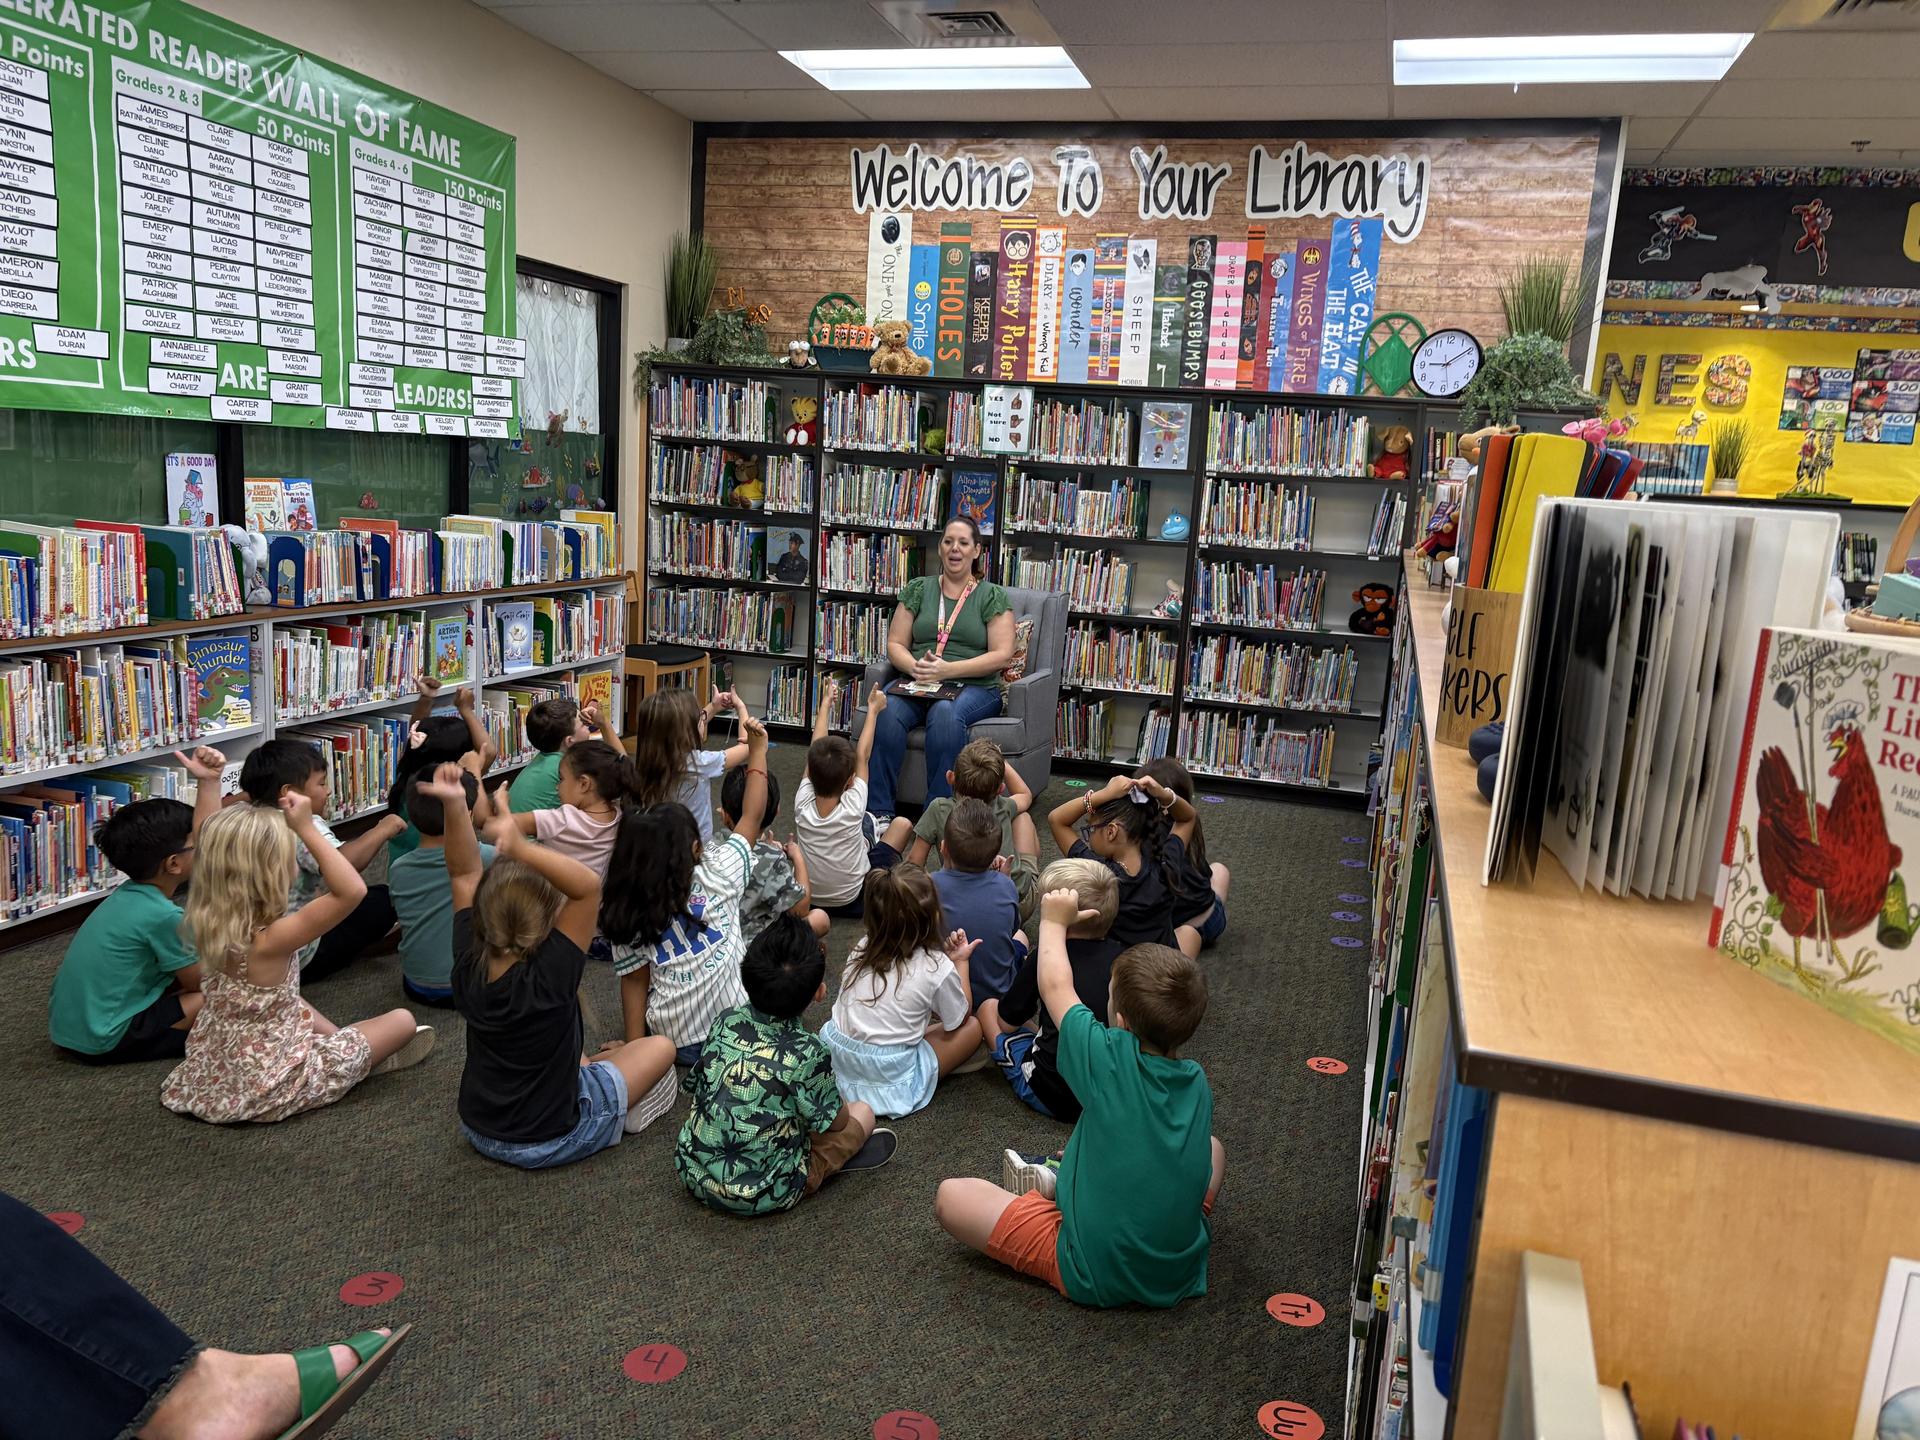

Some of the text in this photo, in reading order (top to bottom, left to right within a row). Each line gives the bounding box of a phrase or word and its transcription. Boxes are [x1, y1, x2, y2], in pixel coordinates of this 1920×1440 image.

[12, 34, 84, 79] Points
[116, 69, 199, 106] Grades 2 & 3
[149, 29, 254, 93] READER
[261, 66, 346, 128] WALL
[355, 103, 390, 142] OF
[399, 118, 461, 168] FAME
[137, 104, 168, 119] JAMES
[207, 124, 234, 138] CLARE
[257, 116, 330, 156] 50 Points
[138, 134, 169, 148] CELINE
[143, 145, 165, 156] DANG
[208, 152, 236, 166] AARAV
[355, 148, 408, 175] Grades 4 6
[133, 160, 178, 178] SANTIAGO
[271, 169, 291, 181] ROSE
[142, 173, 171, 185] RUELAS
[209, 180, 235, 193] KHLOE
[854, 147, 1425, 236] Welcome To Your Library
[140, 192, 175, 205] JOLENE
[261, 192, 304, 209] ALEXANDER
[445, 178, 502, 211] 150 Points
[145, 203, 171, 214] FARLEY
[363, 197, 393, 211] ZACHARY
[206, 207, 240, 221] AUTUMN
[142, 221, 174, 233] EMERY
[207, 217, 240, 231] RICHARDS
[264, 221, 302, 236] PENELOPE
[3, 236, 28, 247] KAUR
[150, 232, 167, 242] DIAZ
[210, 235, 238, 247] LUCAS
[147, 251, 172, 262] ARKIN
[409, 258, 441, 271] CHARLOTTE
[882, 254, 896, 283] ONE
[211, 273, 240, 282] CLAYTON
[270, 273, 302, 286] DOMINIC
[1043, 263, 1055, 299] DIARY
[1350, 267, 1376, 298] THE
[141, 278, 178, 291] PATRICK
[1, 288, 33, 301] DIEGO
[216, 291, 237, 301] JACE
[1298, 271, 1320, 327] WINGS
[0, 299, 37, 311] CARRERA
[276, 301, 298, 310] RHETT
[145, 309, 177, 320] OLIVER
[938, 277, 966, 361] HOLES
[978, 298, 991, 342] KEEPER
[1000, 260, 1029, 380] Harry Potter
[142, 320, 181, 330] GONZALEZ
[210, 318, 244, 328] WESLEY
[913, 302, 931, 350] Smile
[1130, 296, 1143, 354] SHEEP
[1320, 288, 1347, 369] THE HAT
[1347, 303, 1369, 346] CAT
[57, 329, 86, 340] ADAM
[211, 328, 244, 337] FORDHAM
[276, 327, 303, 336] KAYLEE
[1184, 281, 1209, 381] GOOSEBUMPS
[58, 340, 85, 350] DURAN
[1436, 339, 1442, 348] 11
[1447, 336, 1455, 344] 12
[159, 340, 209, 353] ANNABELLE
[1424, 348, 1432, 357] 10
[163, 351, 206, 361] HERNANDEZ
[282, 354, 309, 363] EVELYN
[360, 366, 386, 374] JOCELYN
[1291, 347, 1311, 384] FIRE
[1420, 361, 1426, 369] 9
[1468, 360, 1475, 368] 3
[166, 372, 202, 382] MARTIN
[219, 363, 268, 391] ARE
[1421, 373, 1427, 382] 8
[1464, 372, 1469, 380] 4
[1823, 370, 1852, 379] 000
[169, 382, 199, 392] CHAVEZ
[286, 383, 309, 391] GRANT
[1429, 382, 1435, 390] 7
[1440, 385, 1446, 393] 6
[1453, 381, 1460, 389] 5
[1892, 382, 1918, 391] 300
[362, 389, 382, 397] KADEN
[394, 382, 472, 410] LEADERS!
[227, 399, 259, 409] CARTER
[1821, 402, 1844, 411] 100
[229, 409, 257, 417] WALKER
[337, 410, 364, 419] ARIANNA
[391, 414, 410, 422] CALEB
[1887, 415, 1913, 424] 400
[167, 455, 216, 467] IT'S A GOOD DAY
[250, 625, 259, 642] B
[438, 627, 460, 636] ARTHUR
[188, 641, 245, 666] Dinosaur
[1877, 739, 1920, 773] Re
[1891, 784, 1899, 795] A
[1316, 1059, 1338, 1071] Ss
[356, 1277, 389, 1297] 3
[1278, 1303, 1311, 1318] Tt
[643, 1349, 669, 1375] 4
[1273, 1406, 1307, 1436] Uu
